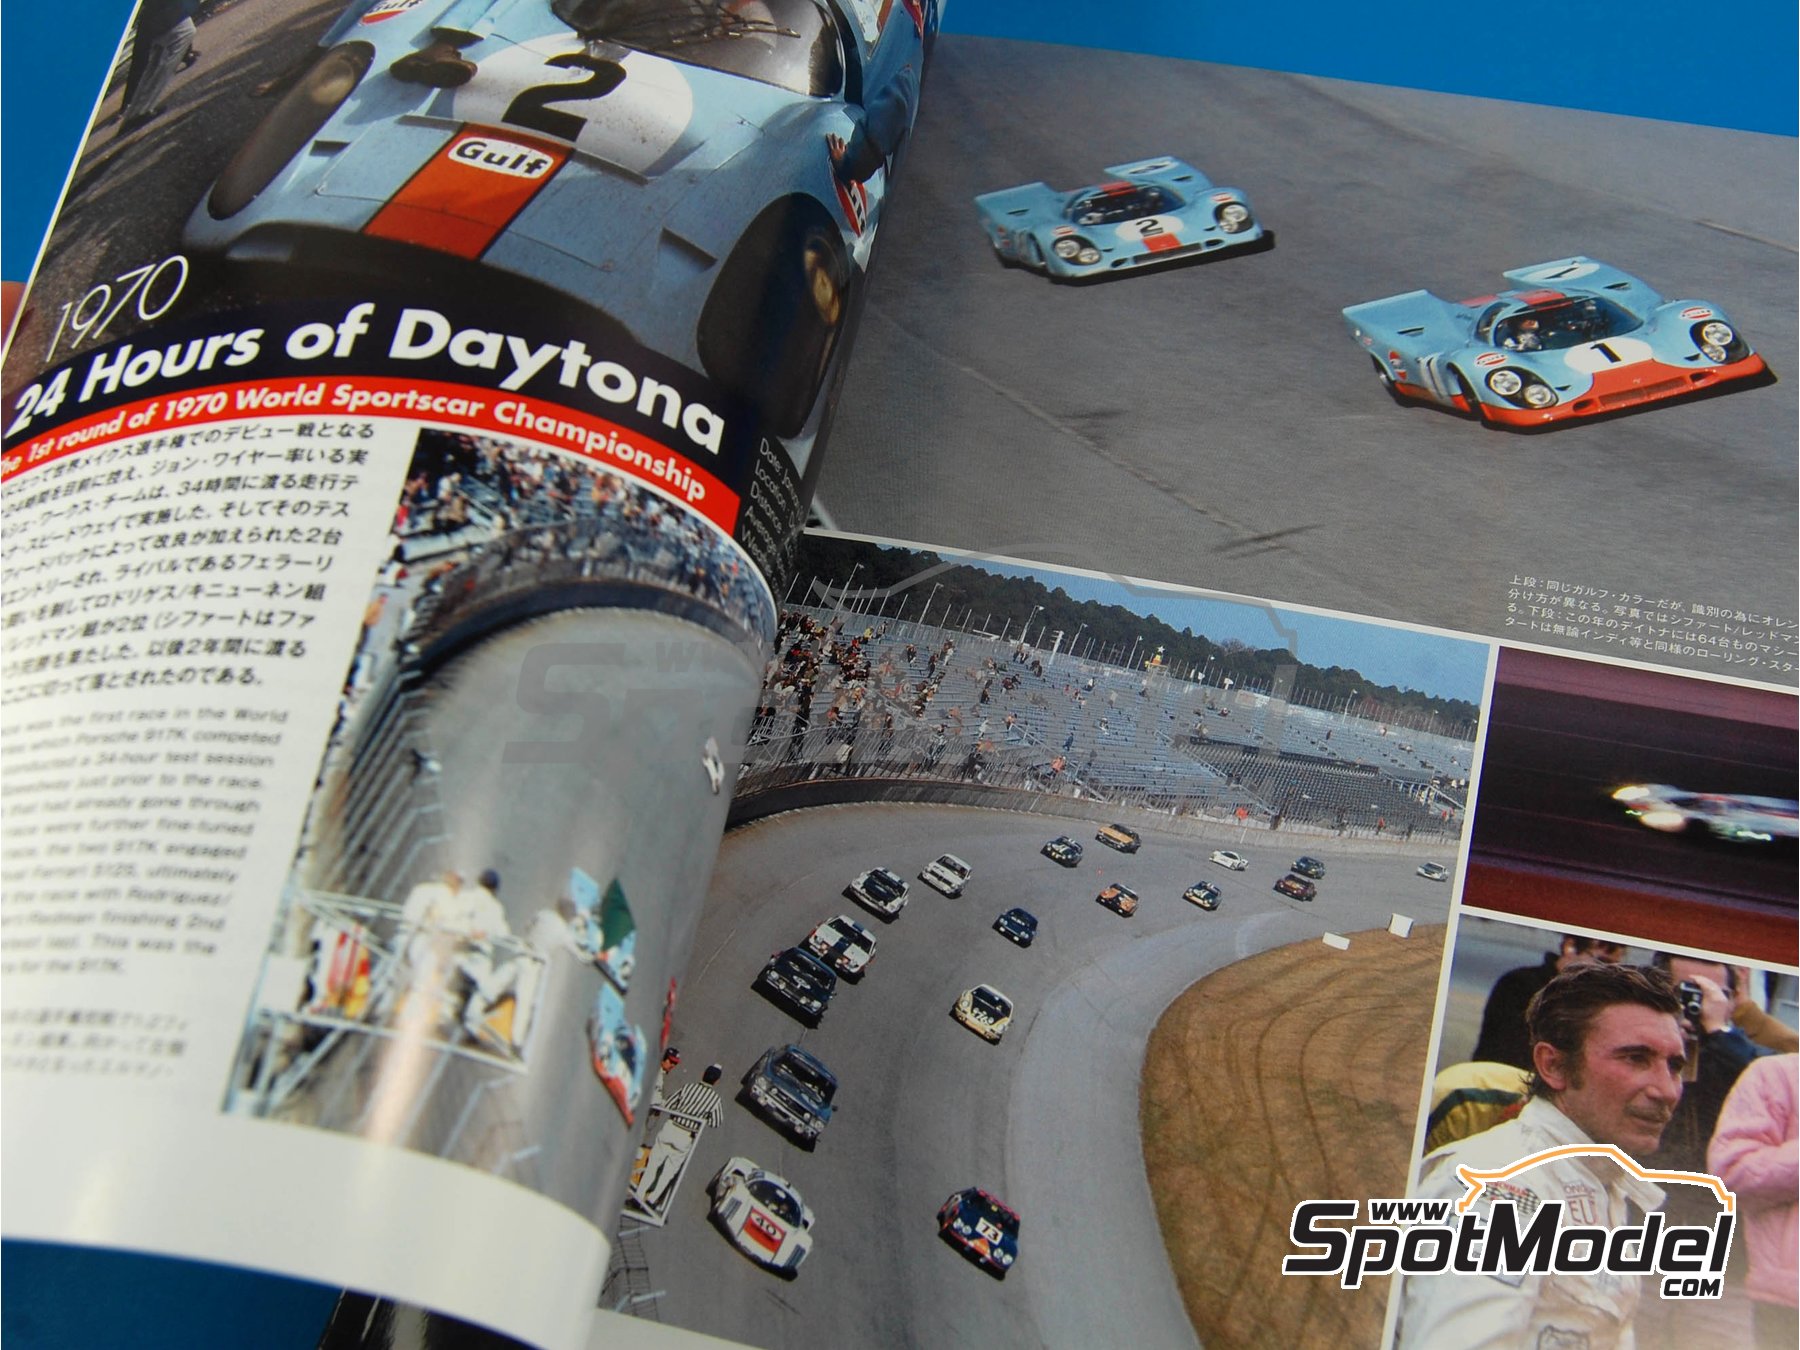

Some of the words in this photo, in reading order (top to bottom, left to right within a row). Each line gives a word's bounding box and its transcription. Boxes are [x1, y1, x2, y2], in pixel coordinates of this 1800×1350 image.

[501, 53, 628, 142] 2
[455, 140, 549, 175] Gulf
[1136, 218, 1164, 237] 2
[46, 255, 189, 363] 1970
[1590, 342, 1622, 364] 1
[3, 367, 73, 439] 24
[79, 328, 265, 403] Hours
[285, 302, 376, 360] of
[389, 308, 726, 455] Daytona
[27, 436, 56, 465] 1st
[59, 412, 130, 452] round
[128, 407, 158, 432] of
[165, 390, 228, 423] 1970
[236, 383, 326, 412] World
[331, 384, 486, 418] Sportscar
[494, 401, 707, 502] Championship
[752, 1210, 783, 1237] 40
[978, 1222, 1003, 1241] 73
